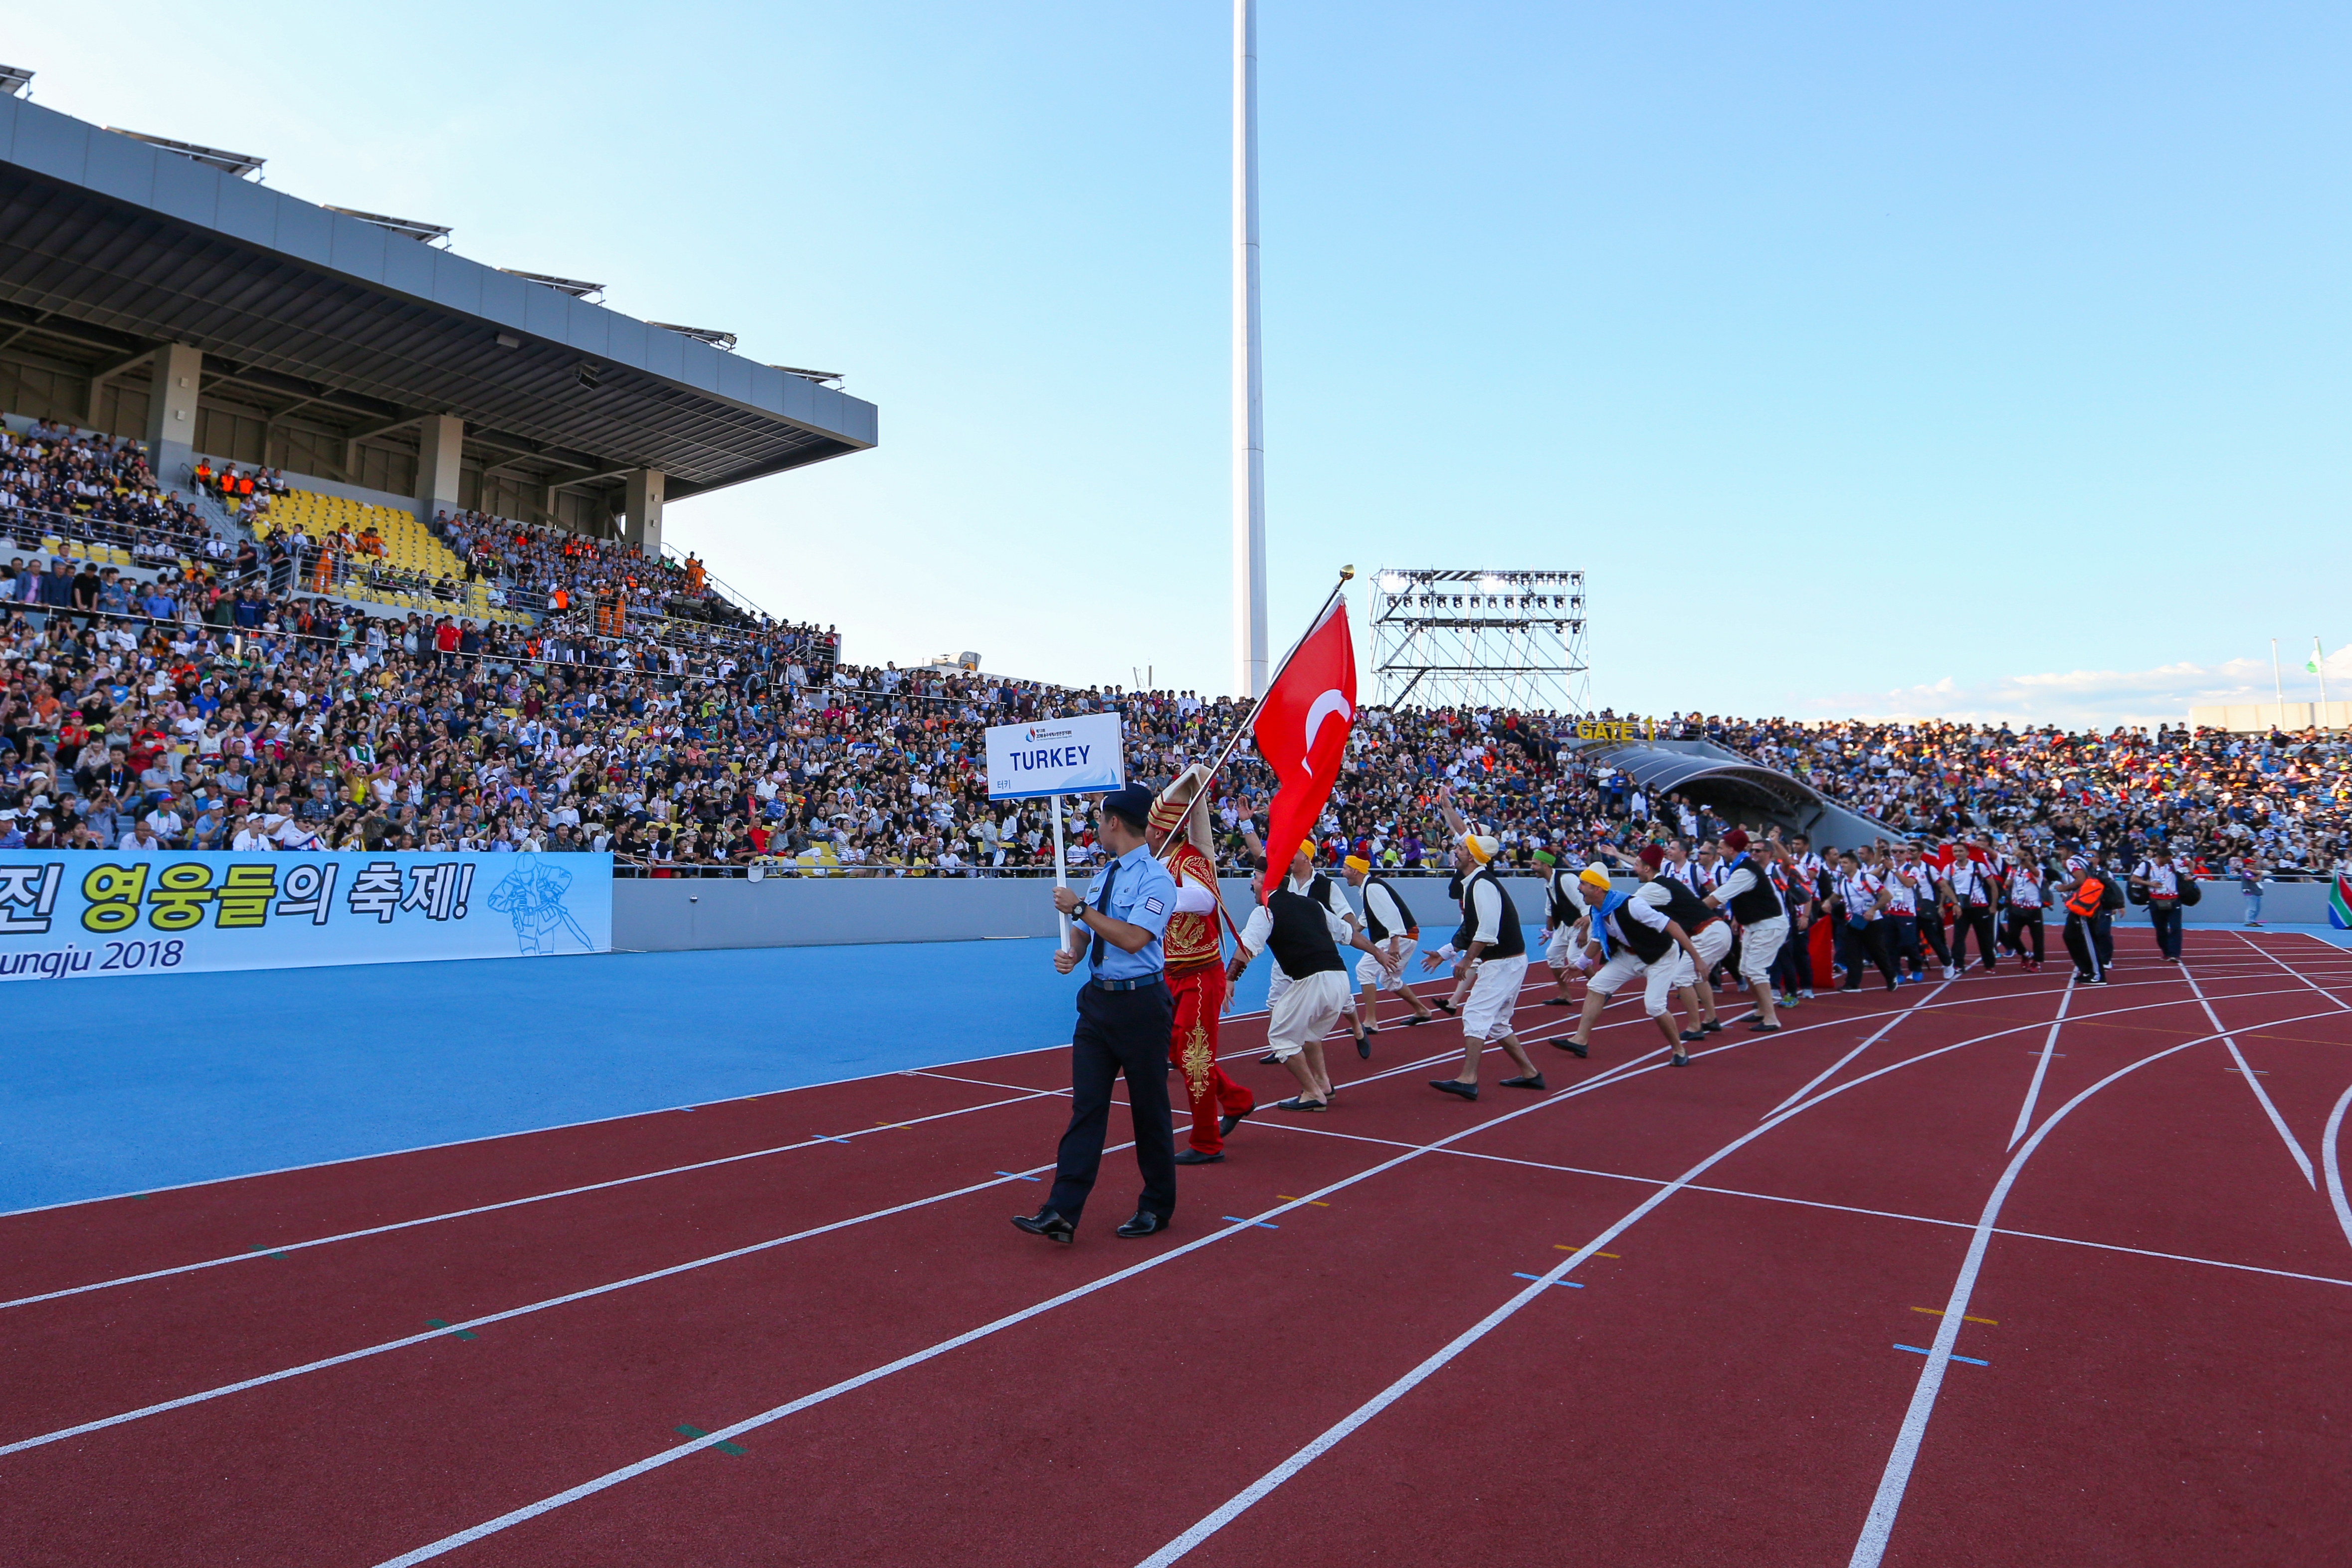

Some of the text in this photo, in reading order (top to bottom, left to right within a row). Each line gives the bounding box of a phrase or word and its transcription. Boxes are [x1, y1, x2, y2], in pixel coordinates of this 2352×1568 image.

[1577, 716, 1655, 741] GATE 1
[1010, 745, 1091, 771] TURKEY
[997, 780, 1011, 789] 터키
[81, 862, 339, 933] 영웅들의
[348, 861, 475, 923] 축제!
[0, 940, 184, 979] ungju 2018
